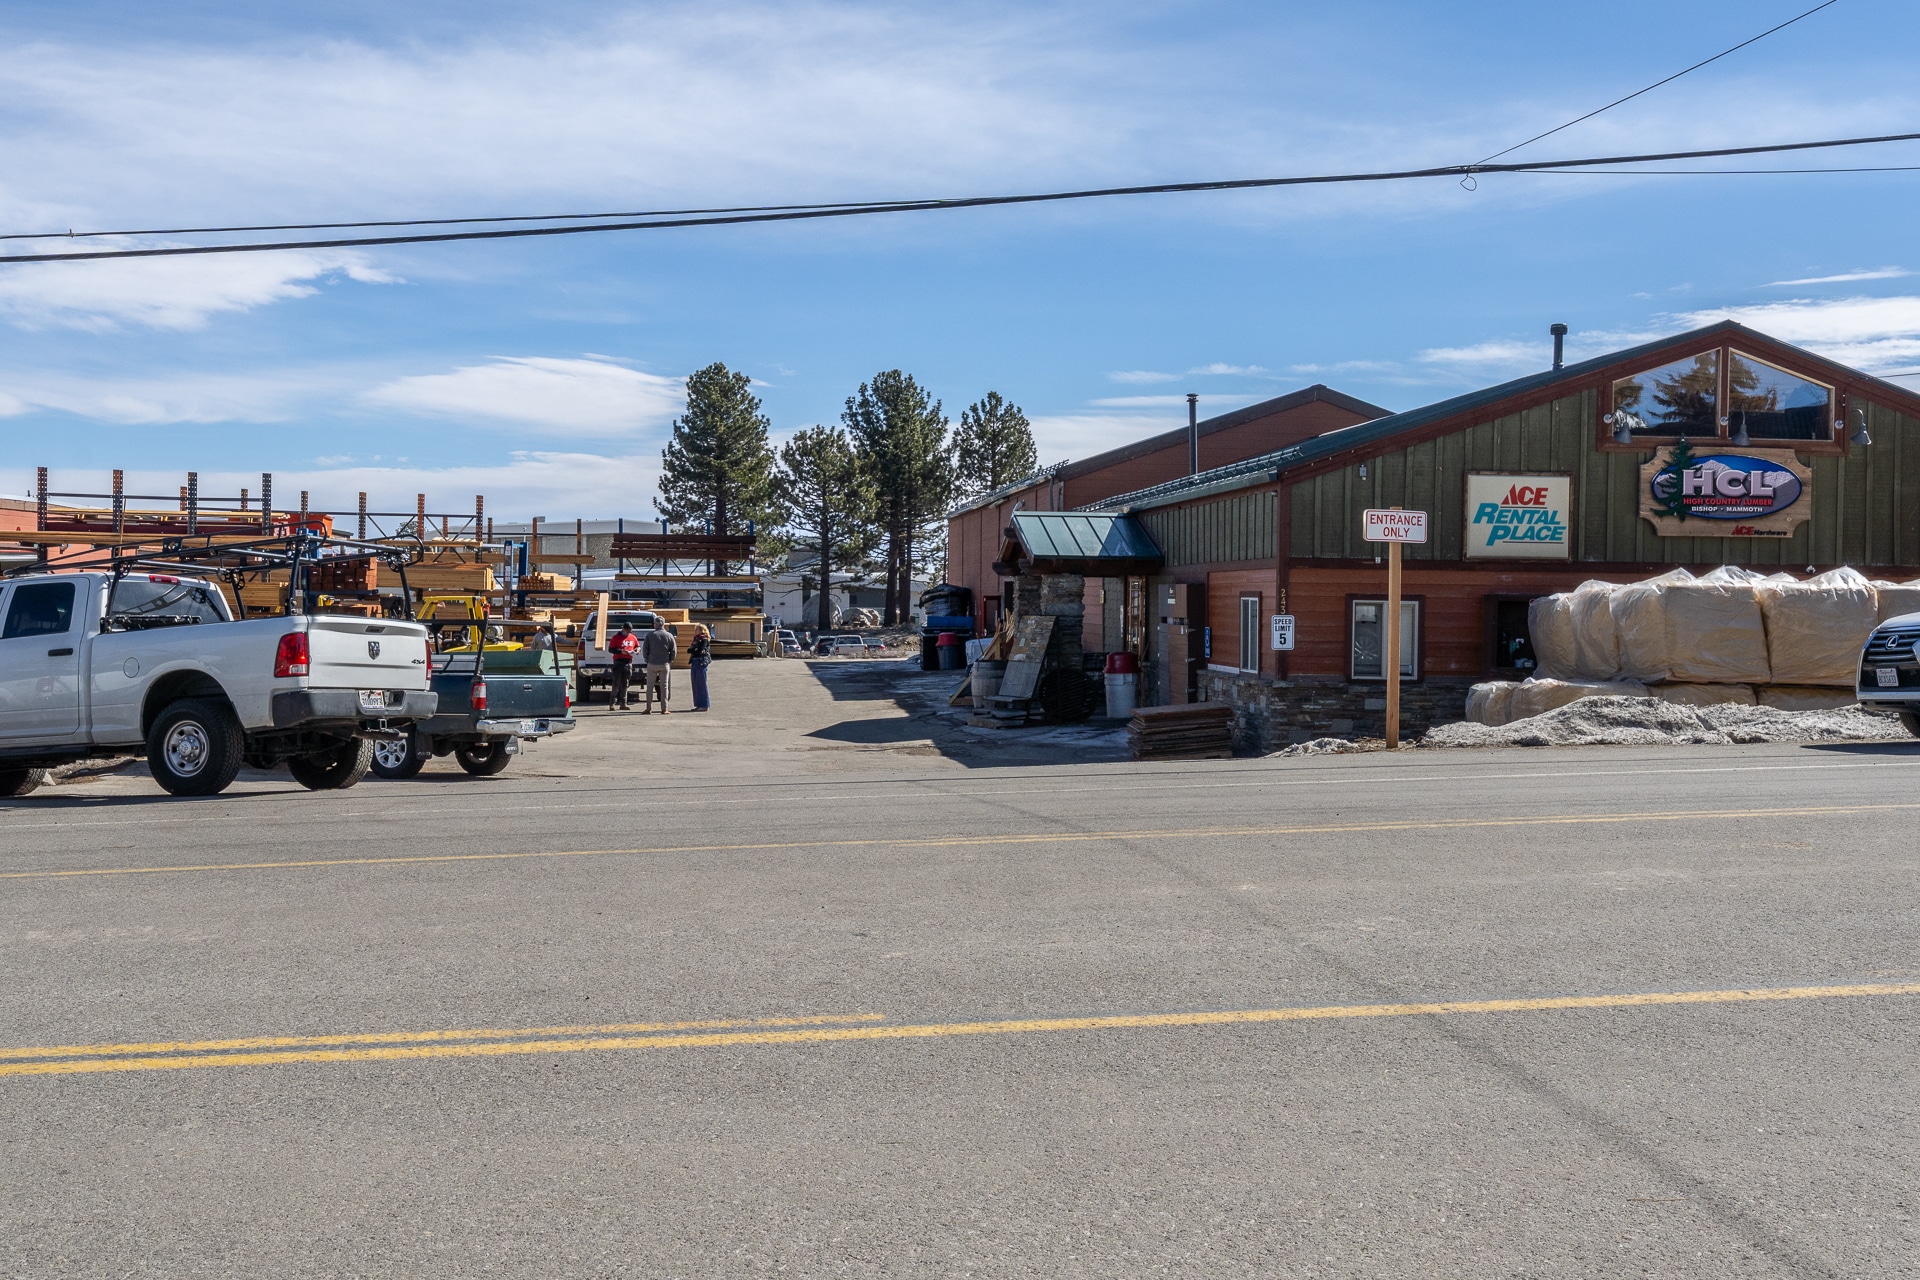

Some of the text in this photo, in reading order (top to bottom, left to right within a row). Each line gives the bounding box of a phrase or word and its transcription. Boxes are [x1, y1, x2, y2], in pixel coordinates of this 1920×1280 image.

[1681, 469, 1774, 497] HCL
[1501, 483, 1549, 506] ACE
[1705, 498, 1742, 506] COUNTRY
[1743, 498, 1773, 506] LUMBER
[1369, 514, 1423, 526] ENTRANCE
[1383, 527, 1410, 538] ONLY
[1731, 524, 1788, 536] ACE Hardware
[1279, 632, 1287, 645] 5
